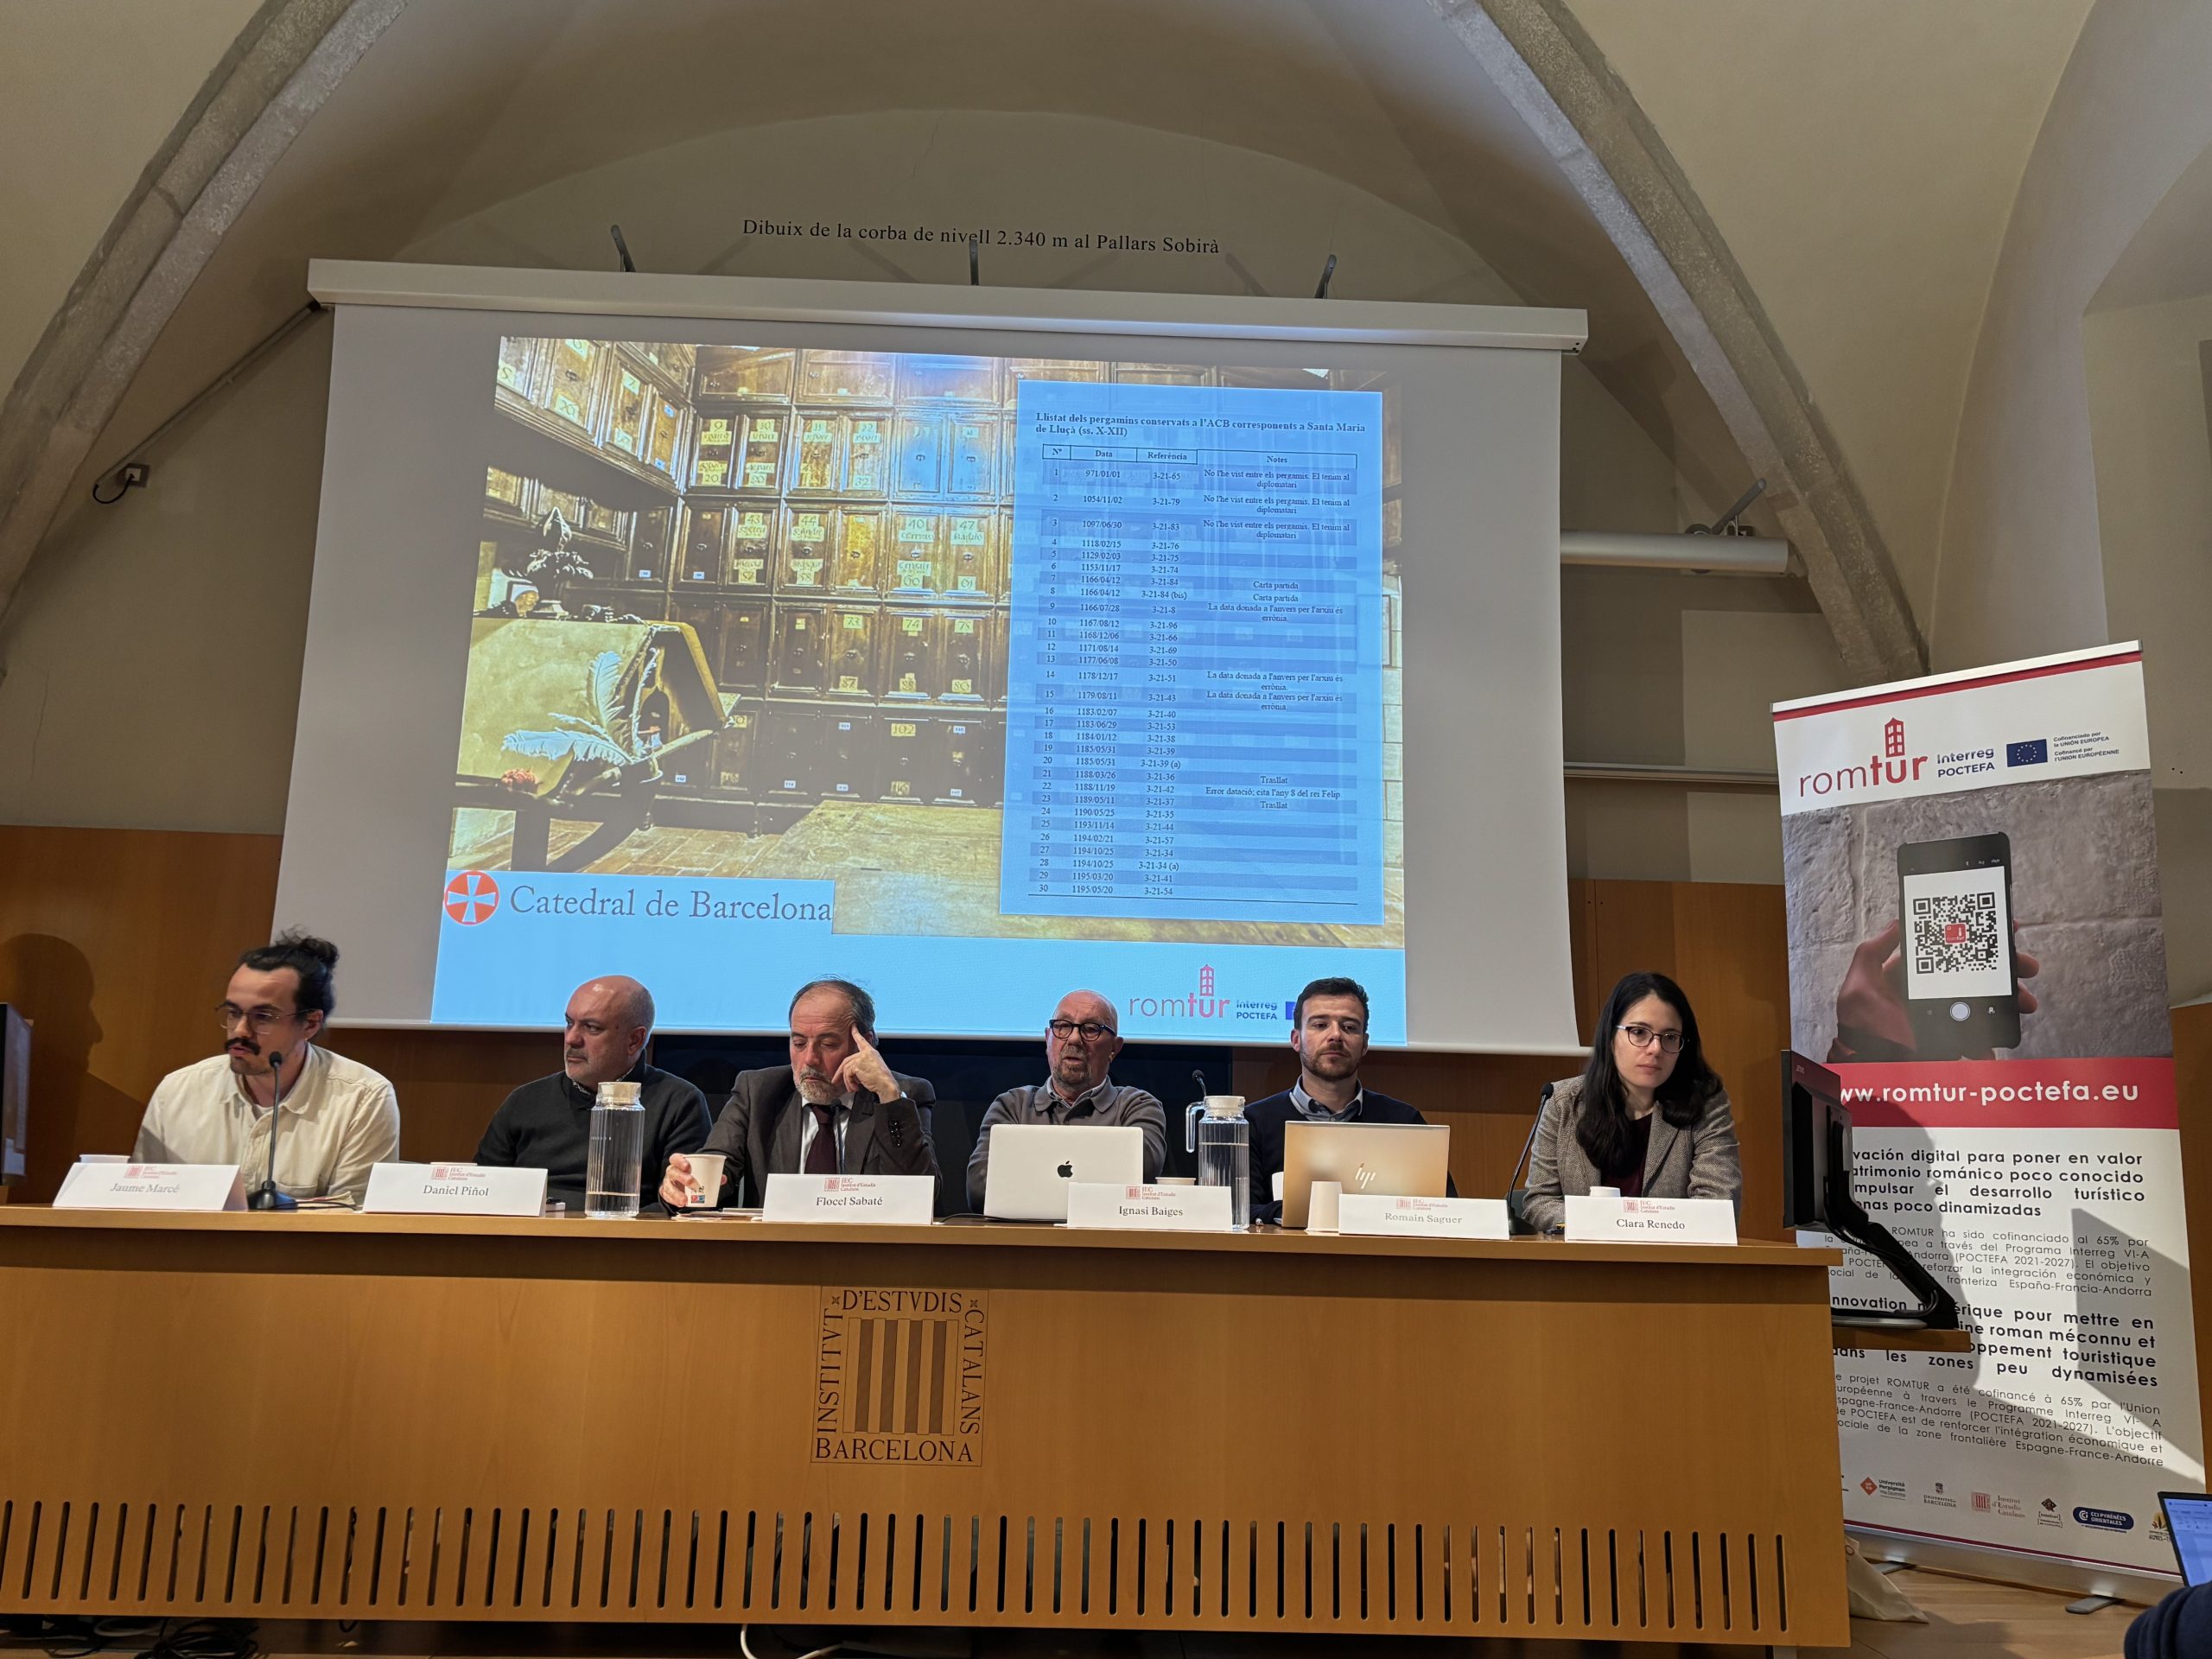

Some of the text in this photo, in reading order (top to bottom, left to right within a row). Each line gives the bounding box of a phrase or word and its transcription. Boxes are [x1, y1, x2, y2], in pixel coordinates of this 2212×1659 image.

[743, 219, 1218, 253] Dibuix de la corba de nivell 2.340 m al Pallars Sobirà
[1036, 425, 1046, 435] de
[1078, 427, 1093, 436] (ss.
[1096, 427, 1128, 437] X-XII)
[1037, 413, 1066, 423] Llistat
[1069, 414, 1087, 424] dels
[1090, 416, 1138, 427] pergamins
[1141, 417, 1189, 427] conservats
[1232, 421, 1297, 431] corresponents
[1306, 422, 1333, 431] Santa
[1337, 423, 1365, 432] Maria
[1171, 591, 1187, 600] (bis)
[1274, 594, 1298, 603] partida
[1799, 754, 1929, 798] romtur
[1937, 762, 1995, 778] POCTEFA
[1075, 783, 1116, 791] 1188/11/19
[1072, 885, 1113, 893] 1195/05/20
[511, 885, 833, 921] Catedral de Barcelona
[1129, 993, 1230, 1018] romtur
[1853, 1148, 2142, 1166] vación digital para poner en valor
[1853, 1166, 2144, 1184] atrimonio románico poco conocido
[111, 1183, 180, 1192] Jaume Marcé
[423, 1185, 489, 1196] Daniel Piñol
[1855, 1183, 2145, 1202] mpulsar el desarrollo turístico
[849, 1197, 882, 1205] Sabaté
[1894, 1202, 1933, 1215] poco
[1939, 1202, 2041, 1217] dinamizadas
[1119, 1205, 1183, 1217] Ignasi Baiges
[1385, 1212, 1462, 1224] Romain Saguer
[1617, 1219, 1685, 1230] Clara Renedo
[1892, 1227, 1934, 1236] ROMTUR
[1963, 1230, 1984, 1239] sido
[1993, 1232, 2069, 1243] cofinanciado
[2078, 1236, 2088, 1244] al
[2097, 1236, 2119, 1245] 65%
[2128, 1239, 2149, 1248] por
[1955, 1253, 2008, 1264] (POCTEFA
[2086, 1260, 2094, 1268] El
[2101, 1261, 2150, 1272] objetivo
[1947, 1275, 2152, 1296] fronteriza España-Francia-Andorra
[842, 1289, 962, 1313] D'ESTVDIS
[1832, 1295, 2153, 1329] nnovation pour mettre en
[1990, 1325, 2155, 1349] roman méconnu et
[2063, 1347, 2156, 1370] touristique
[817, 1308, 842, 1433] INSTITVT
[960, 1309, 985, 1434] CATALANS
[1886, 1351, 2158, 1388] les zones peu dynamisées
[1850, 1375, 1879, 1384] projet
[1887, 1378, 1929, 1390] ROMTUR
[1953, 1385, 1970, 1395] été
[1979, 1389, 2036, 1402] cofinancé
[2044, 1395, 2052, 1403] à
[2061, 1396, 2083, 1407] 65%
[2092, 1401, 2111, 1410] par
[2120, 1402, 2159, 1414] l'Union
[816, 1437, 973, 1462] BARCELONA
[1951, 1433, 2163, 1466] frontalière Espagne-France-Andorre
